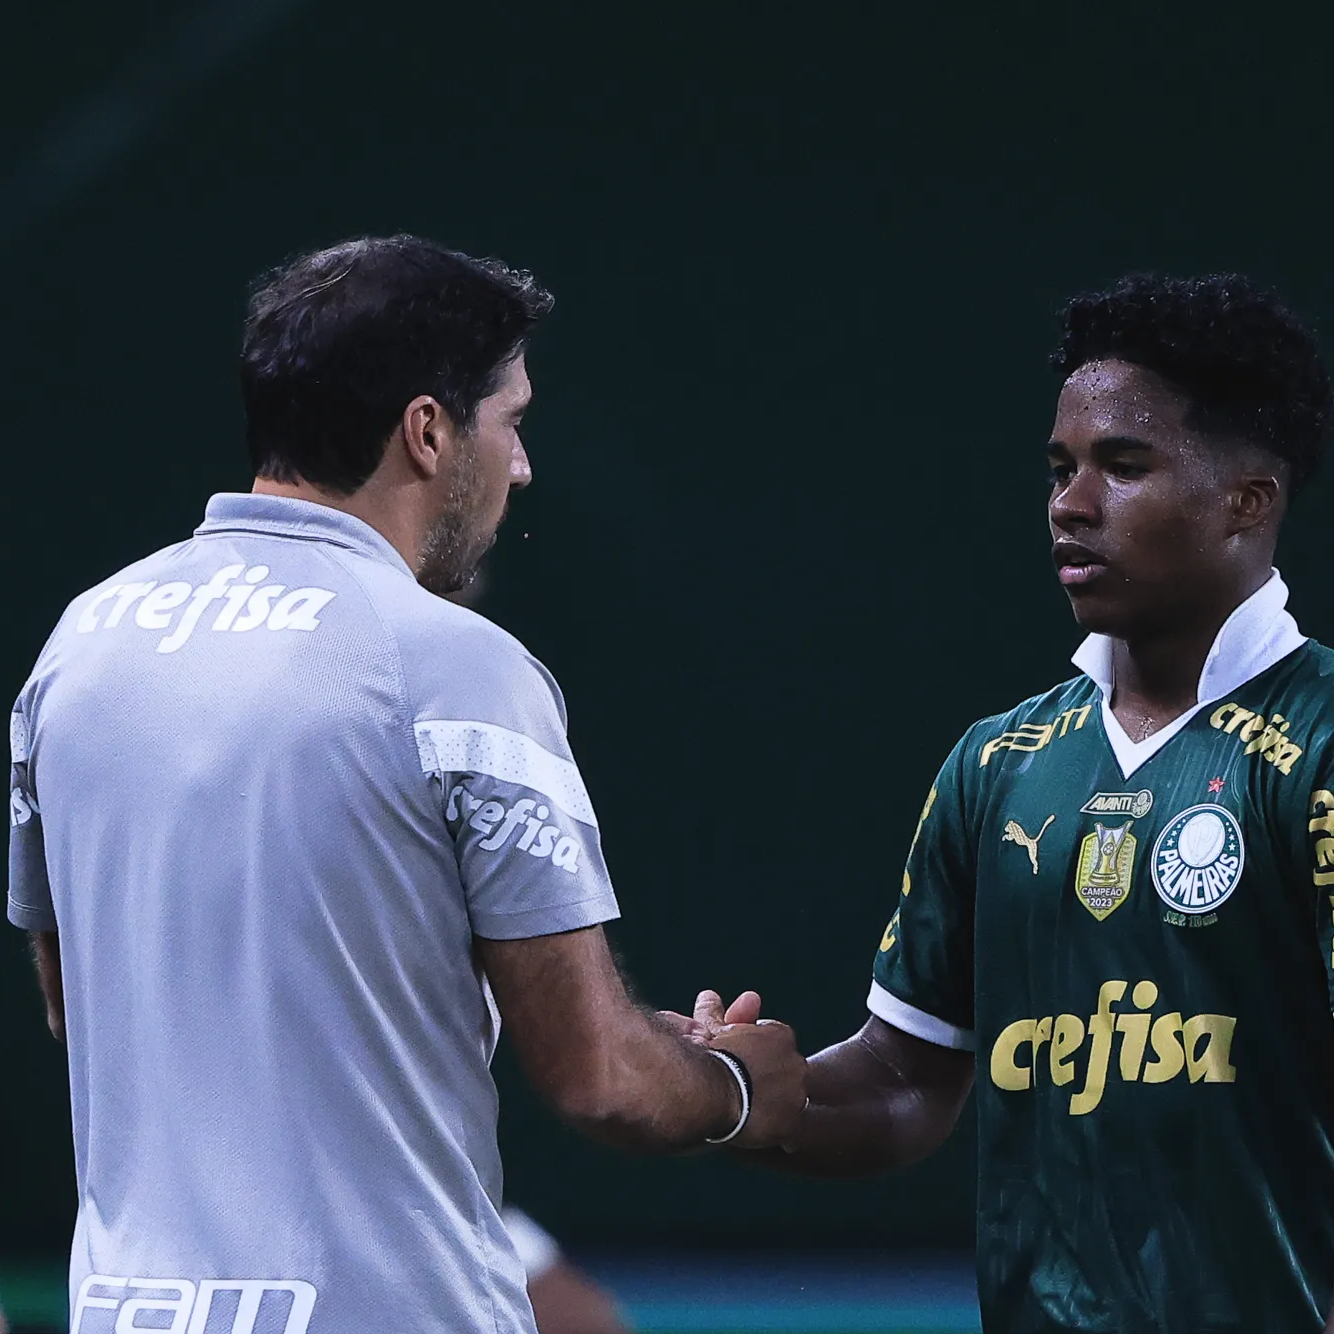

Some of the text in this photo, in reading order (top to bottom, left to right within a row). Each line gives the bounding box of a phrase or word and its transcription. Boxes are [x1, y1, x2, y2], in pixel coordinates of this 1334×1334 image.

[76, 564, 338, 654] crefisa
[1088, 796, 1133, 811] AVANTI
[1090, 897, 1113, 908] 2023
[1159, 849, 1240, 906] PALMEIRAS
[990, 979, 1238, 1116] crefisa
